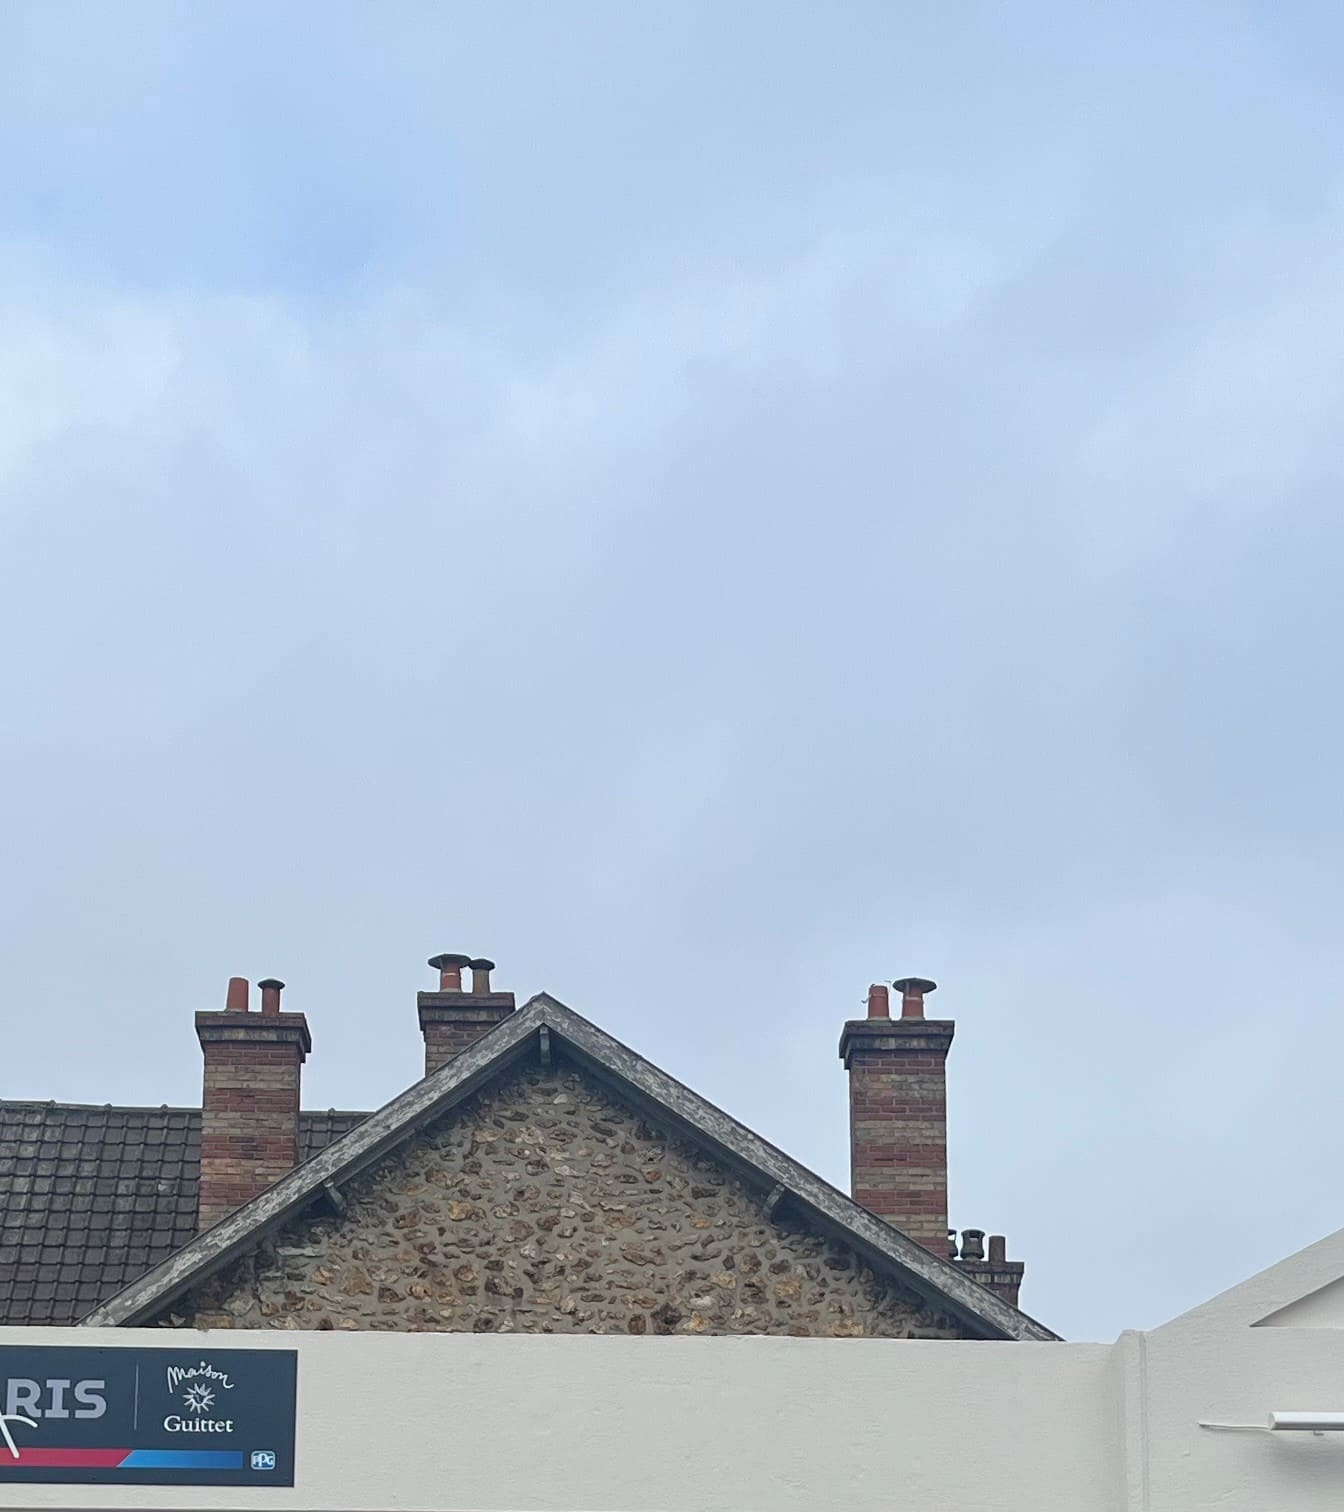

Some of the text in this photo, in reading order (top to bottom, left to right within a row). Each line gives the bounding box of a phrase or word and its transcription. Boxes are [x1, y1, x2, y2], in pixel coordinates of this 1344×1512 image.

[166, 1360, 235, 1394] Maison
[163, 1415, 234, 1433] Guittet
[252, 1452, 274, 1468] PPG
